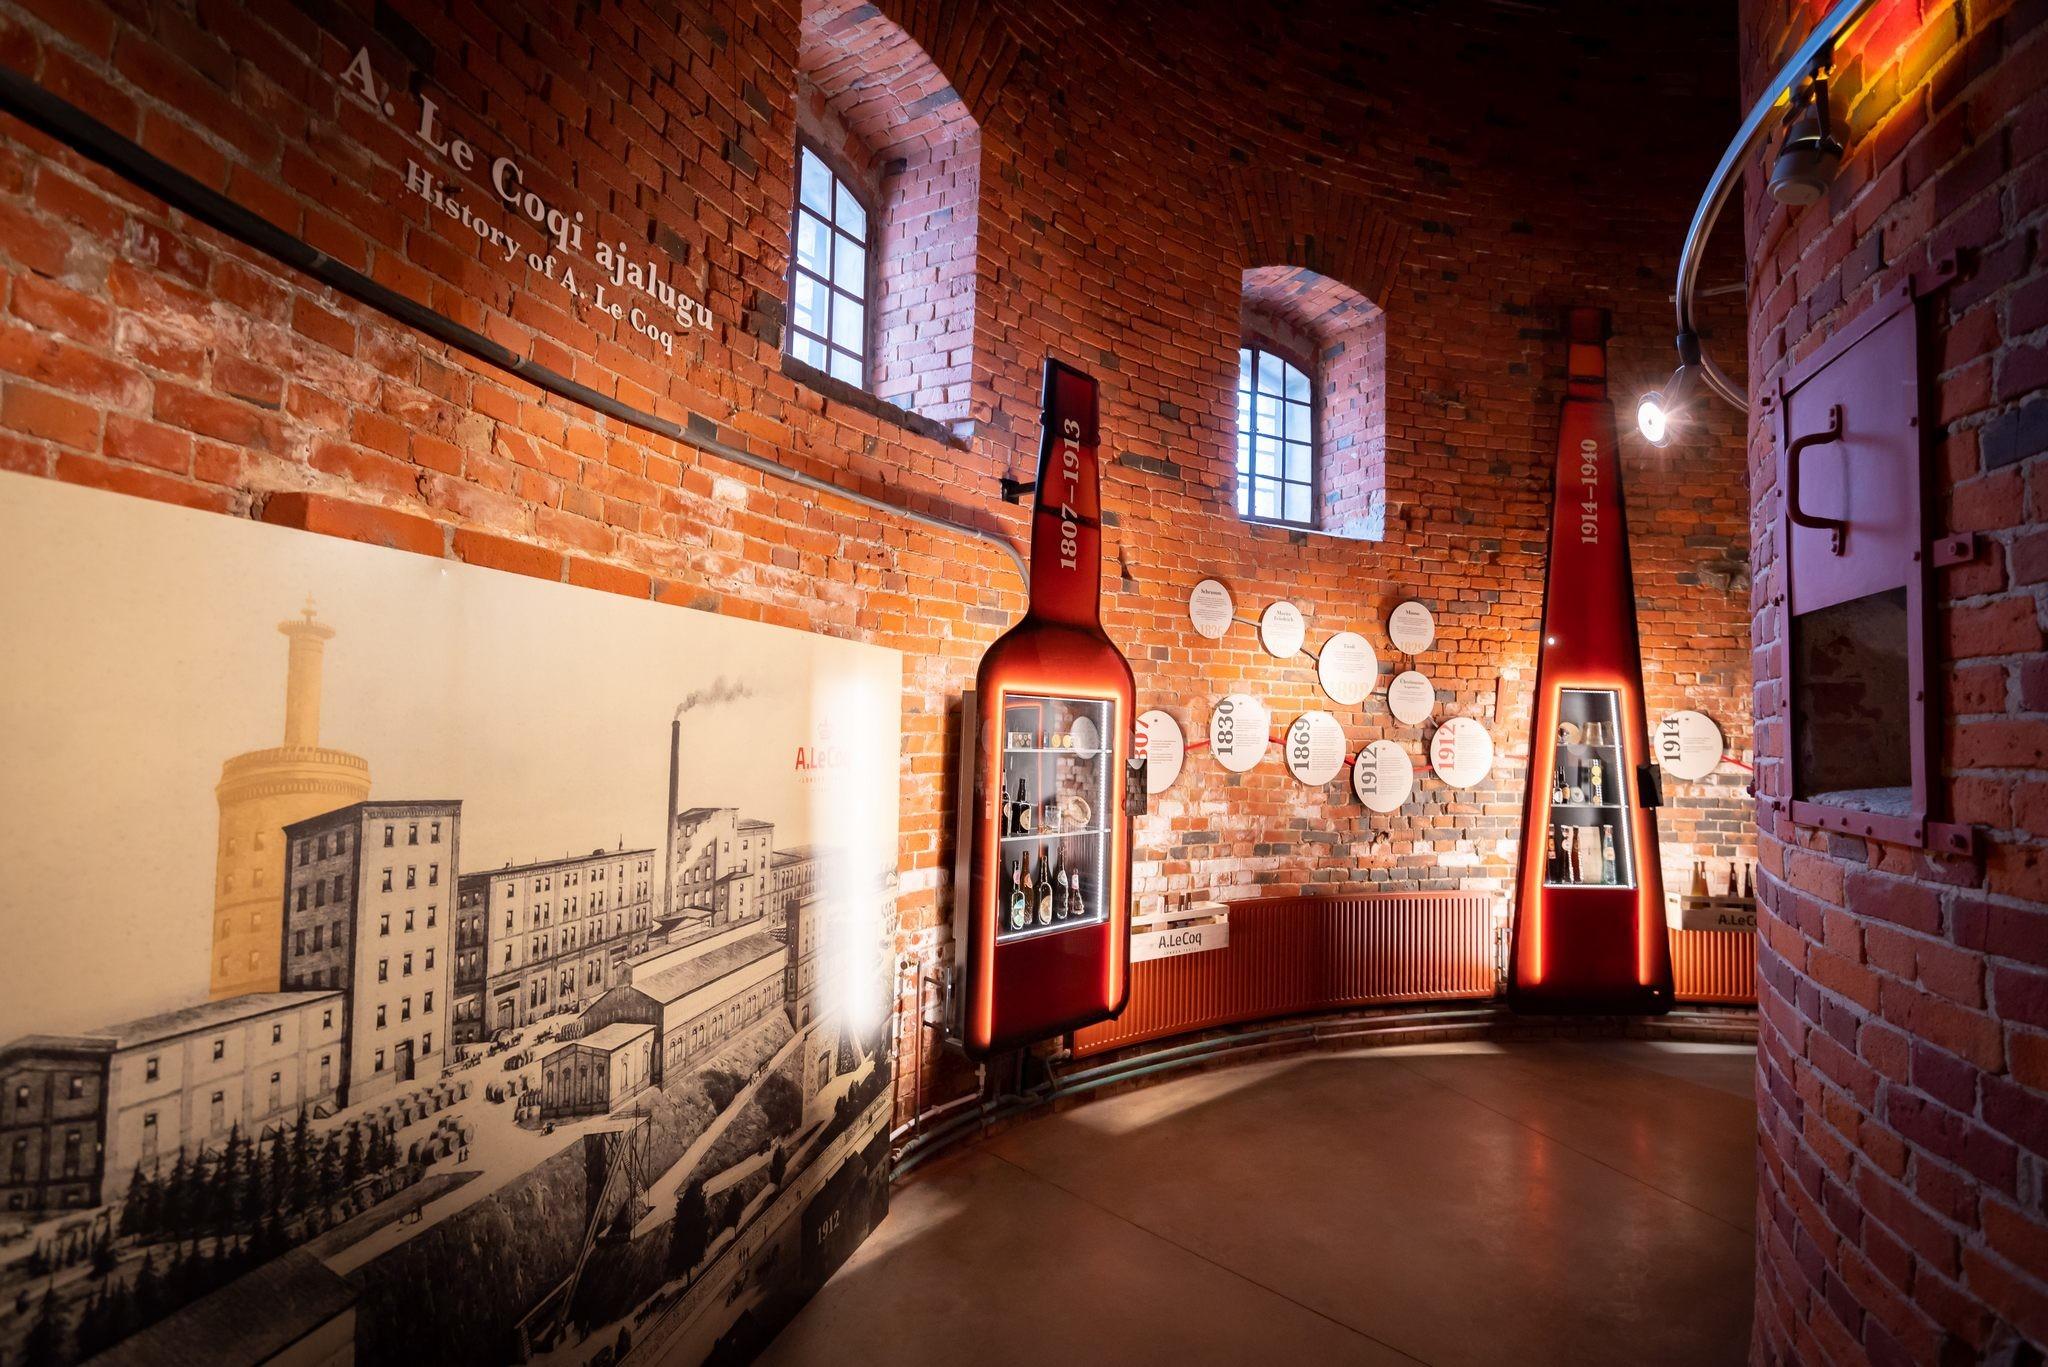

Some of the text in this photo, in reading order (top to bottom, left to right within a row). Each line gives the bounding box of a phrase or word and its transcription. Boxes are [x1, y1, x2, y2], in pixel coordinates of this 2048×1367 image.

[339, 45, 714, 331] A. Le Coqi ajalugu
[405, 158, 674, 356] History of A. Le Coq
[1218, 700, 1234, 756] 1830
[1294, 718, 1311, 771] 1869
[1438, 723, 1456, 770] 1912
[1662, 717, 1681, 762] 1914
[1361, 746, 1378, 796] 1912
[817, 1209, 840, 1245] 1912
